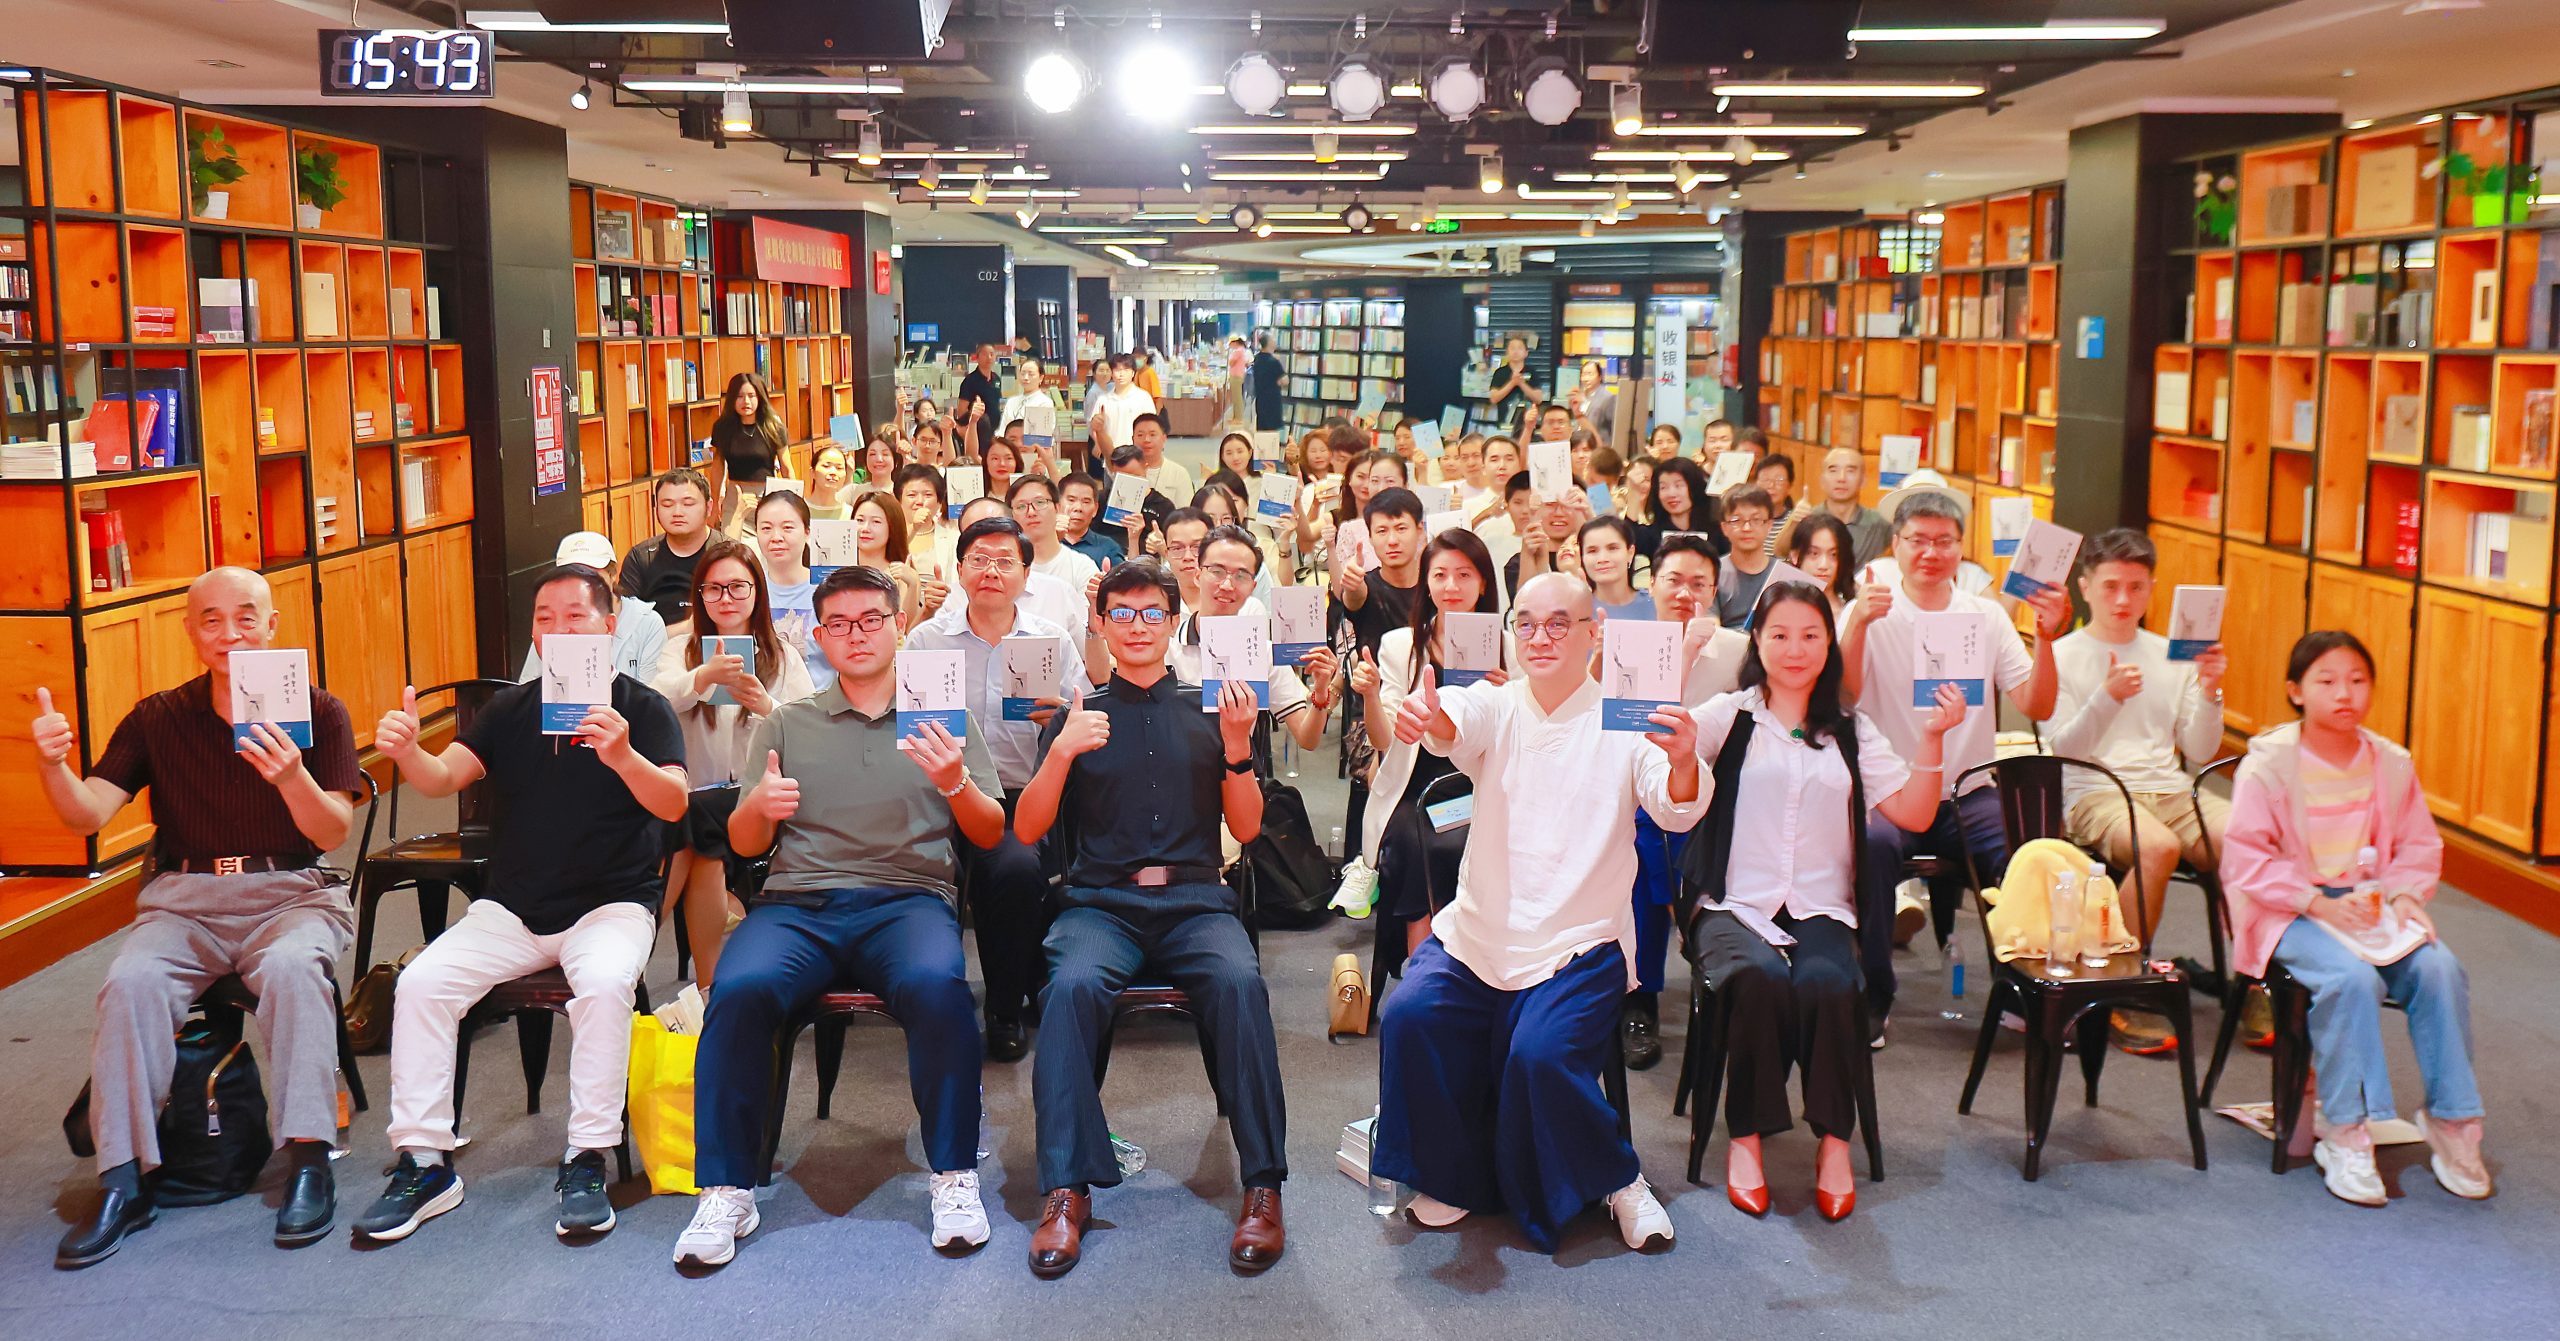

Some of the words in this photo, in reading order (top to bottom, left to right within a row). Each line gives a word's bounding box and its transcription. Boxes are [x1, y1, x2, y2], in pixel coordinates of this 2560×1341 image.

[351, 34, 481, 91] 15:43
[977, 270, 999, 282] C02
[1434, 244, 1523, 277] 文学馆
[1661, 330, 1679, 387] 收银处
